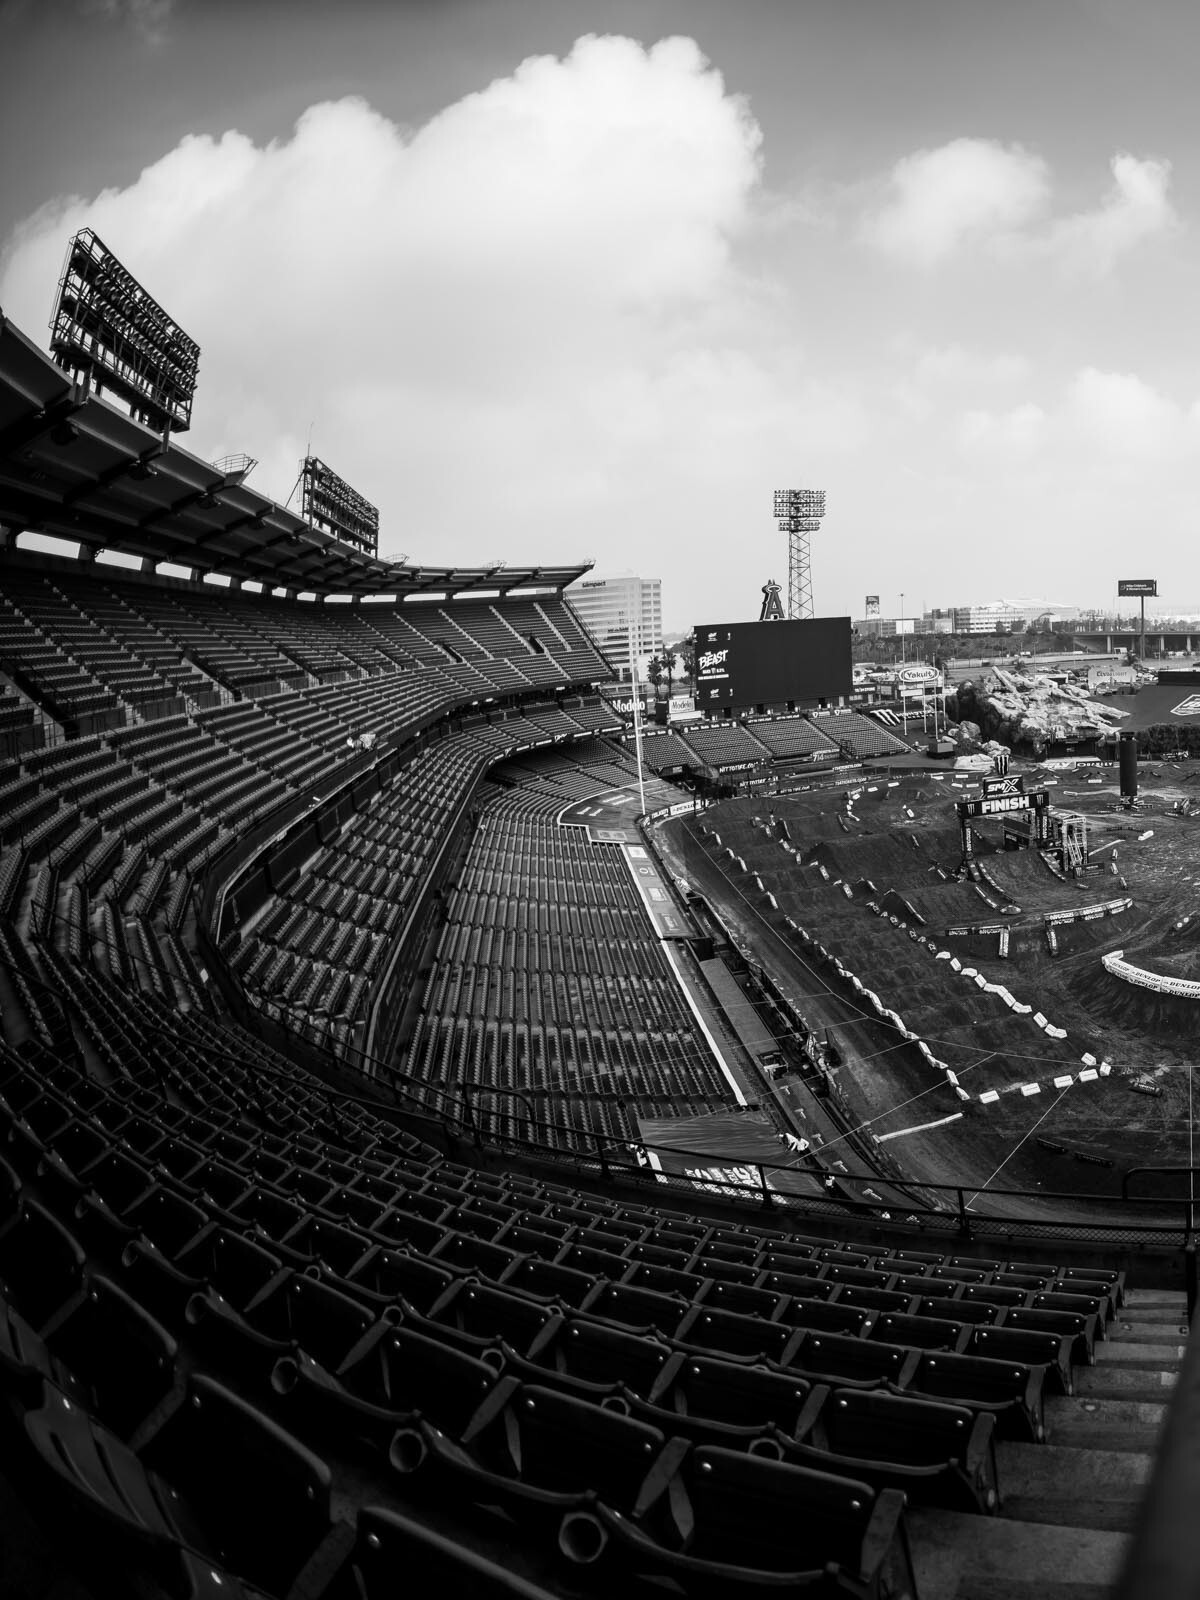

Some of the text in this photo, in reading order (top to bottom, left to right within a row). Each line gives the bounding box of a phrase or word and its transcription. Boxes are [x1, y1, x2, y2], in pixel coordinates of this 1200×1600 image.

[698, 650, 729, 670] BEAST
[907, 670, 932, 679] Yakult
[671, 701, 692, 710] Modelo
[987, 778, 1019, 793] SMX
[981, 796, 1030, 814] FINISH
[1135, 971, 1161, 983] DUNLOP
[1169, 990, 1200, 998] DUNLOP
